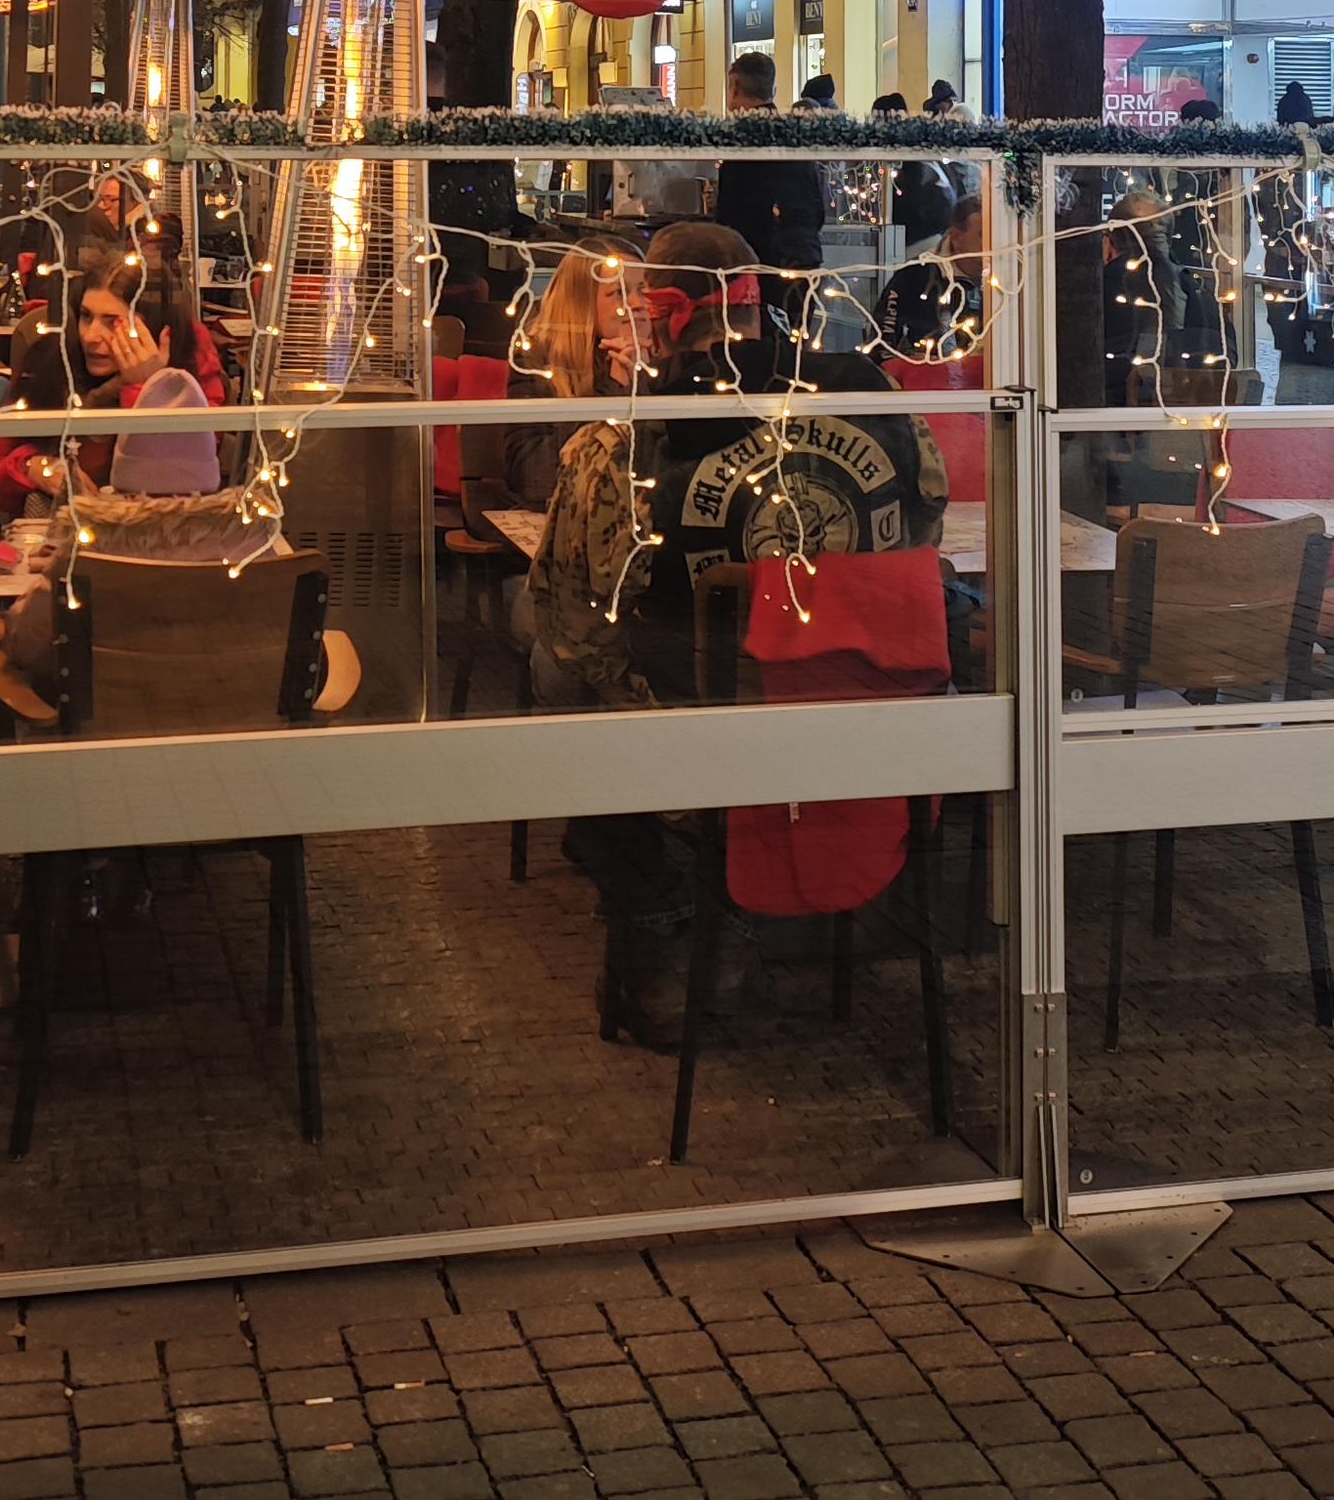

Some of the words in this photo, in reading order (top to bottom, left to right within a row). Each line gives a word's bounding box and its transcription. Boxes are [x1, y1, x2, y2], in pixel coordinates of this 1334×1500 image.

[882, 289, 900, 334] ALPHA
[693, 434, 765, 522] Metal
[782, 415, 881, 483] Skulls
